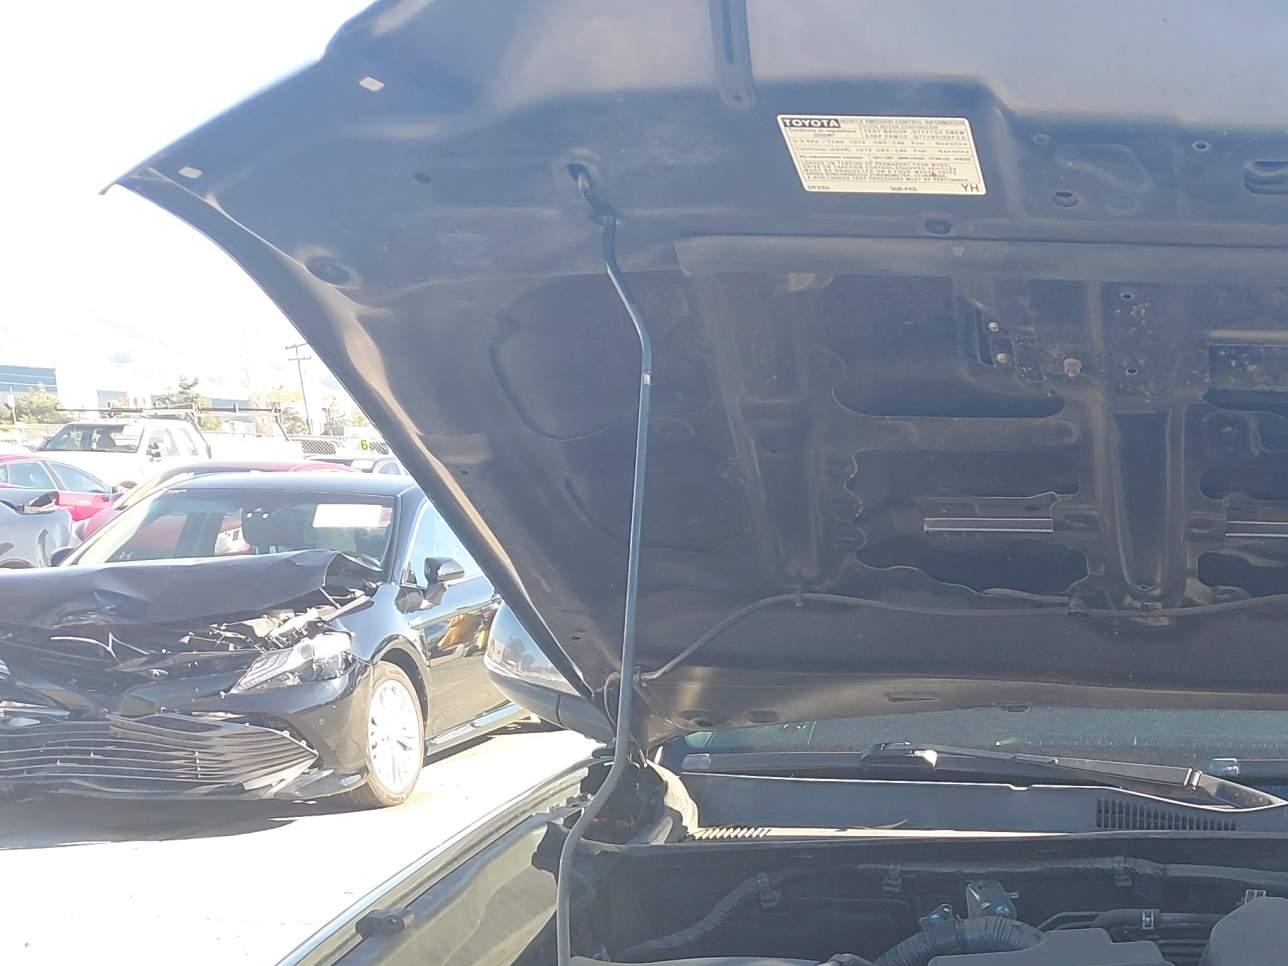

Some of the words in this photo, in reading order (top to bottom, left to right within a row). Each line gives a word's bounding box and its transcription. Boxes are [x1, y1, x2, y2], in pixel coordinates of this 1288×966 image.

[783, 119, 839, 127] TOYOTA
[961, 184, 979, 192] YH
[361, 439, 368, 450] 6
